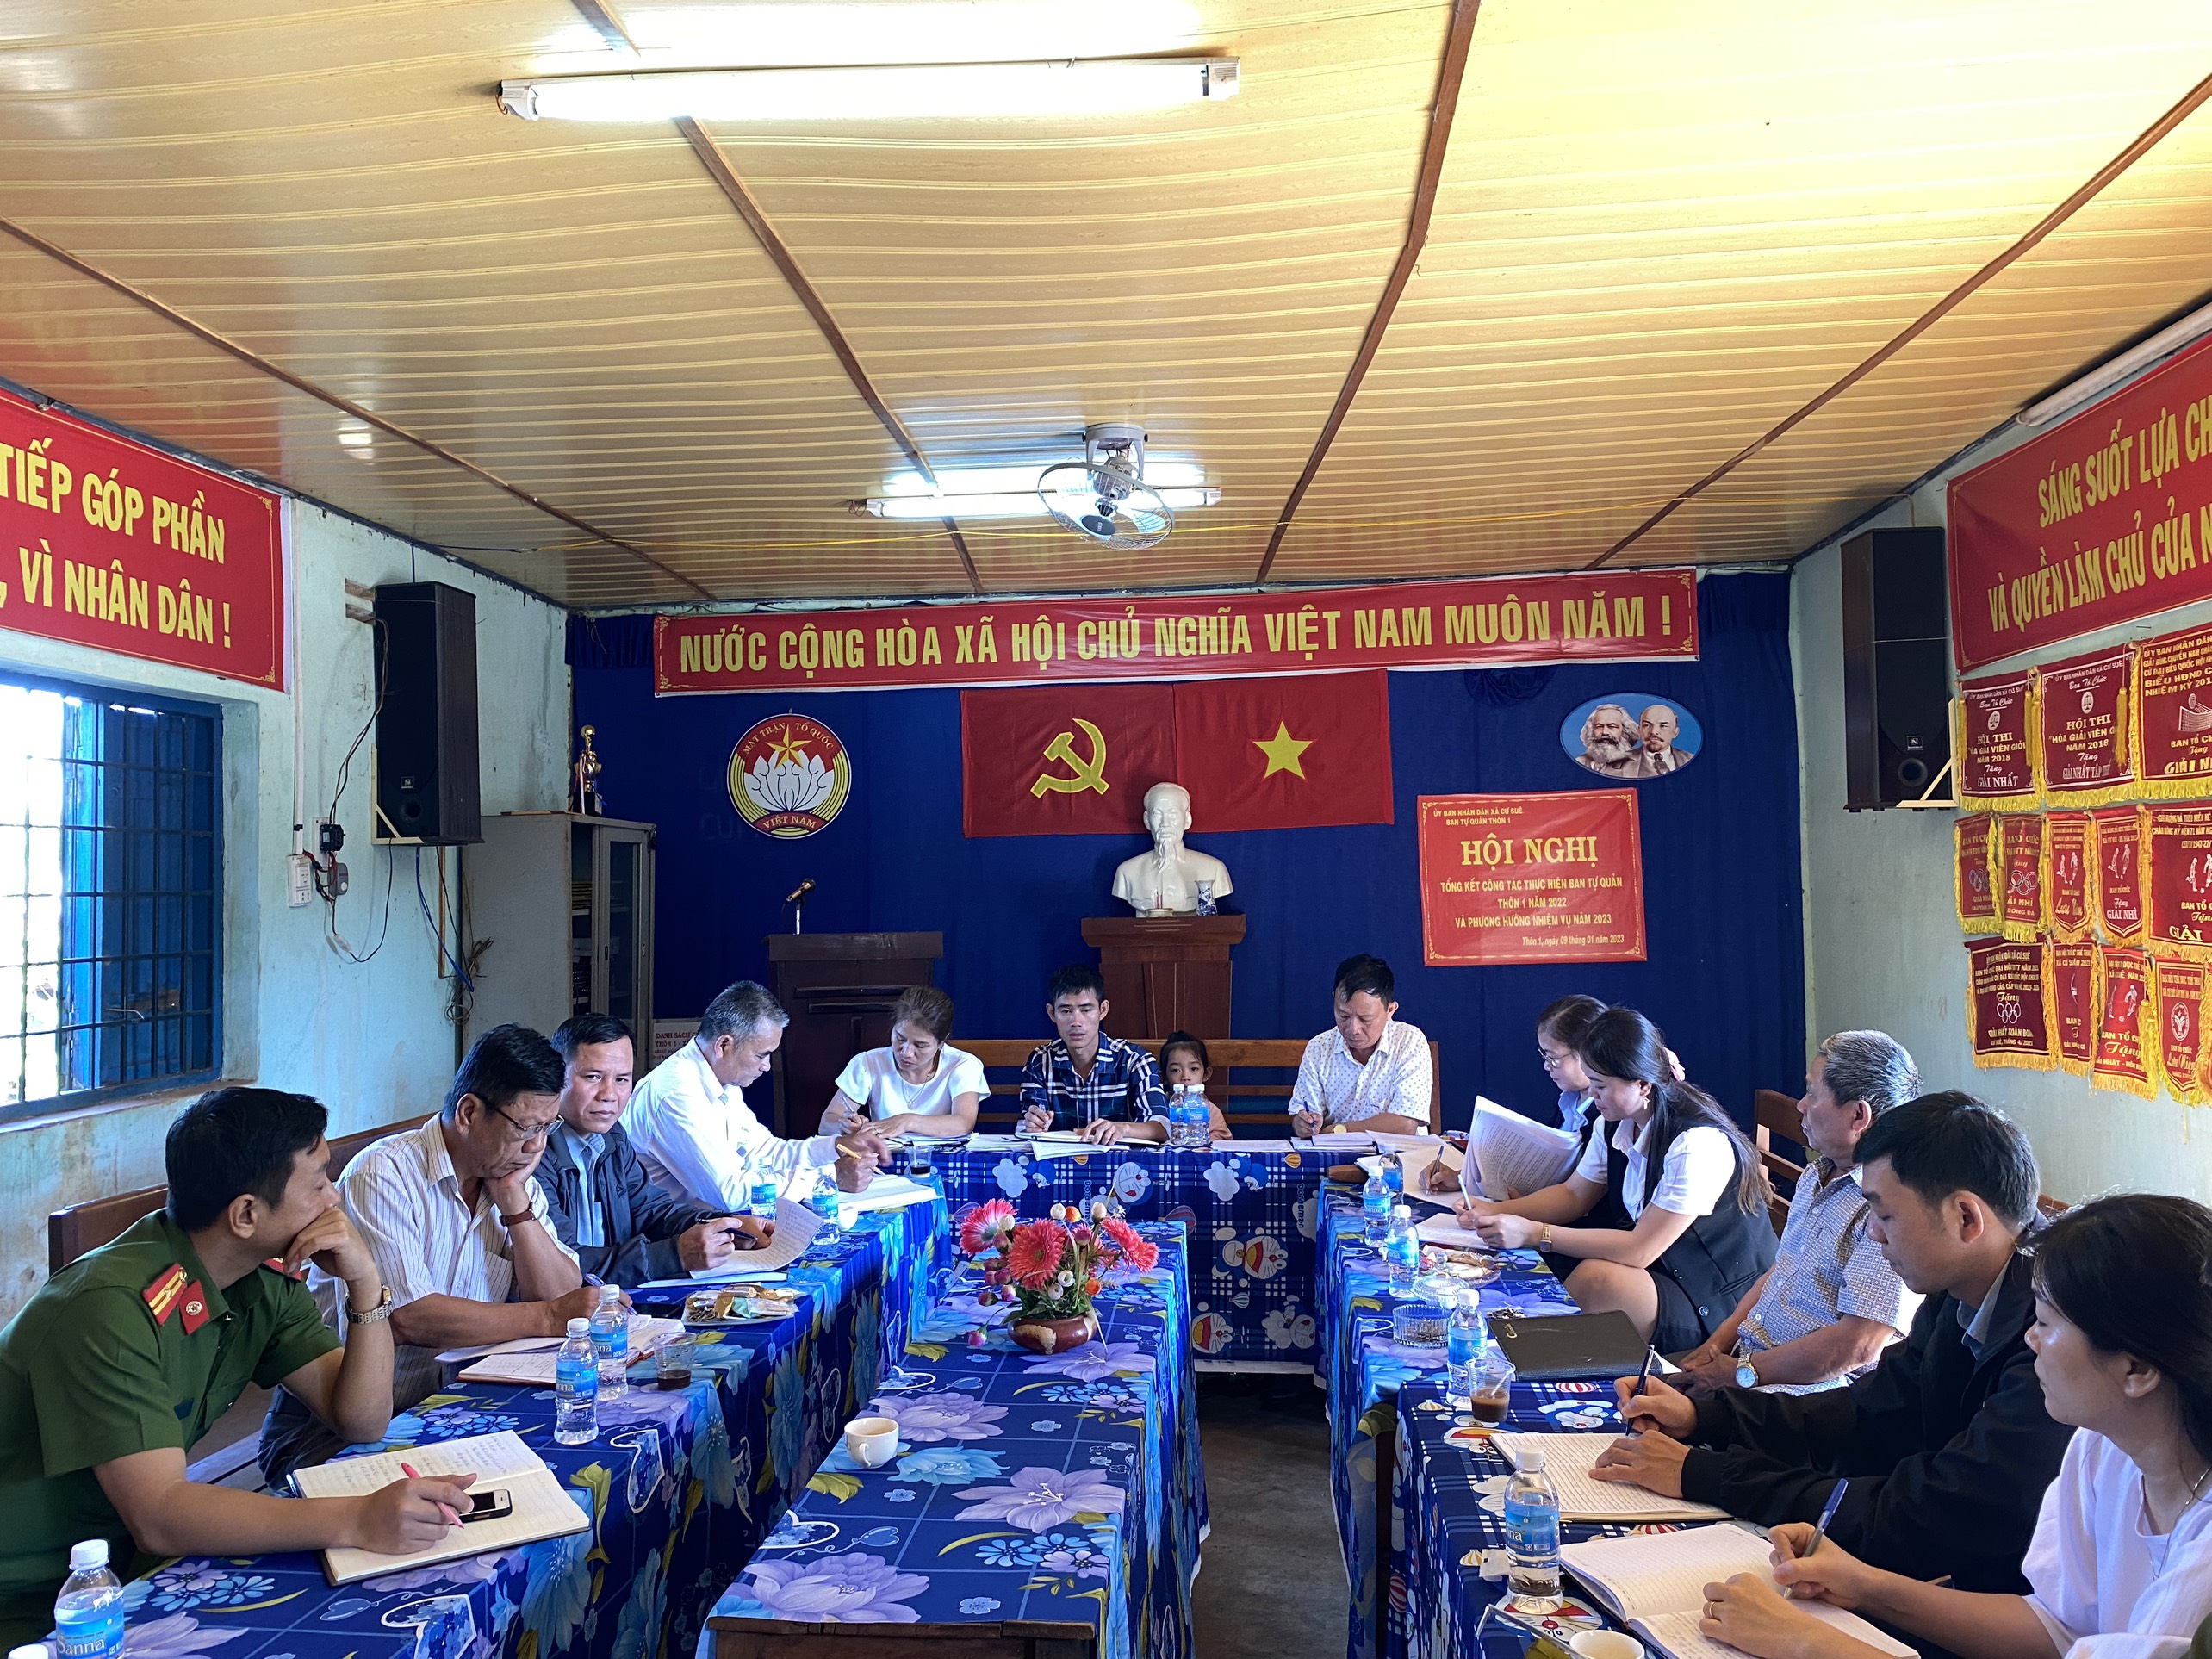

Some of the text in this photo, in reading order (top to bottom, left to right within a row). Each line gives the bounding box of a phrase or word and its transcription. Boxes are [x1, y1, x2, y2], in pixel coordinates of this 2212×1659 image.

[2038, 459, 2083, 528] SÁNG
[2085, 419, 2133, 506] SUỐT
[2140, 407, 2180, 489] LỰA
[0, 437, 225, 564] TIẾP GÓP PHẦN
[1988, 496, 2196, 633] VÀ QUYỀN LÀM CHỦ CỦA
[19, 538, 231, 648] VÌ NHÂN DÂN !
[680, 591, 1672, 678] NƯỚC CỘNG HÒA XÃ HỘI CHỦ NGHĨA VIỆT NAM MUÔN NĂM !
[2145, 686, 2178, 696] NHIỆM
[2066, 714, 2111, 730] HỘI THI
[743, 721, 833, 755] MẶT TRẬN TỔ QUỐC
[1993, 732, 2013, 743] THI
[2088, 727, 2107, 739] VIÊN
[1991, 743, 2010, 753] VIÊN
[2088, 739, 2109, 749] 2018
[2171, 738, 2189, 748] BAN
[1993, 772, 2018, 787] NHẤT
[1433, 809, 1443, 817] ỦY
[1457, 808, 1476, 817] NHÂN
[763, 815, 816, 829] VIỆT NAM
[1461, 818, 1469, 827] TỰ
[1470, 817, 1488, 826] QUẢN
[1461, 832, 1599, 871] HỘI NGHỊ
[1440, 873, 1622, 893] TỔNG KẾT CÔNG TÁC THỰC HIỆN BAN TỰ QUẢN
[1498, 897, 1567, 909] THÔN 1 NĂM 2022
[1455, 912, 1612, 929] VÀ PHƯƠNG HƯỚNG NHIỆM VỤ NĂM 2023
[1522, 936, 1536, 946] Thôn
[1545, 936, 1559, 947] ngày
[1560, 936, 1568, 945] 09
[1569, 935, 1586, 946] tháng
[1587, 935, 1594, 944] 01
[1610, 935, 1624, 943] 2023
[556, 1382, 575, 1391] nna
[56, 1635, 106, 1656] Sanna
